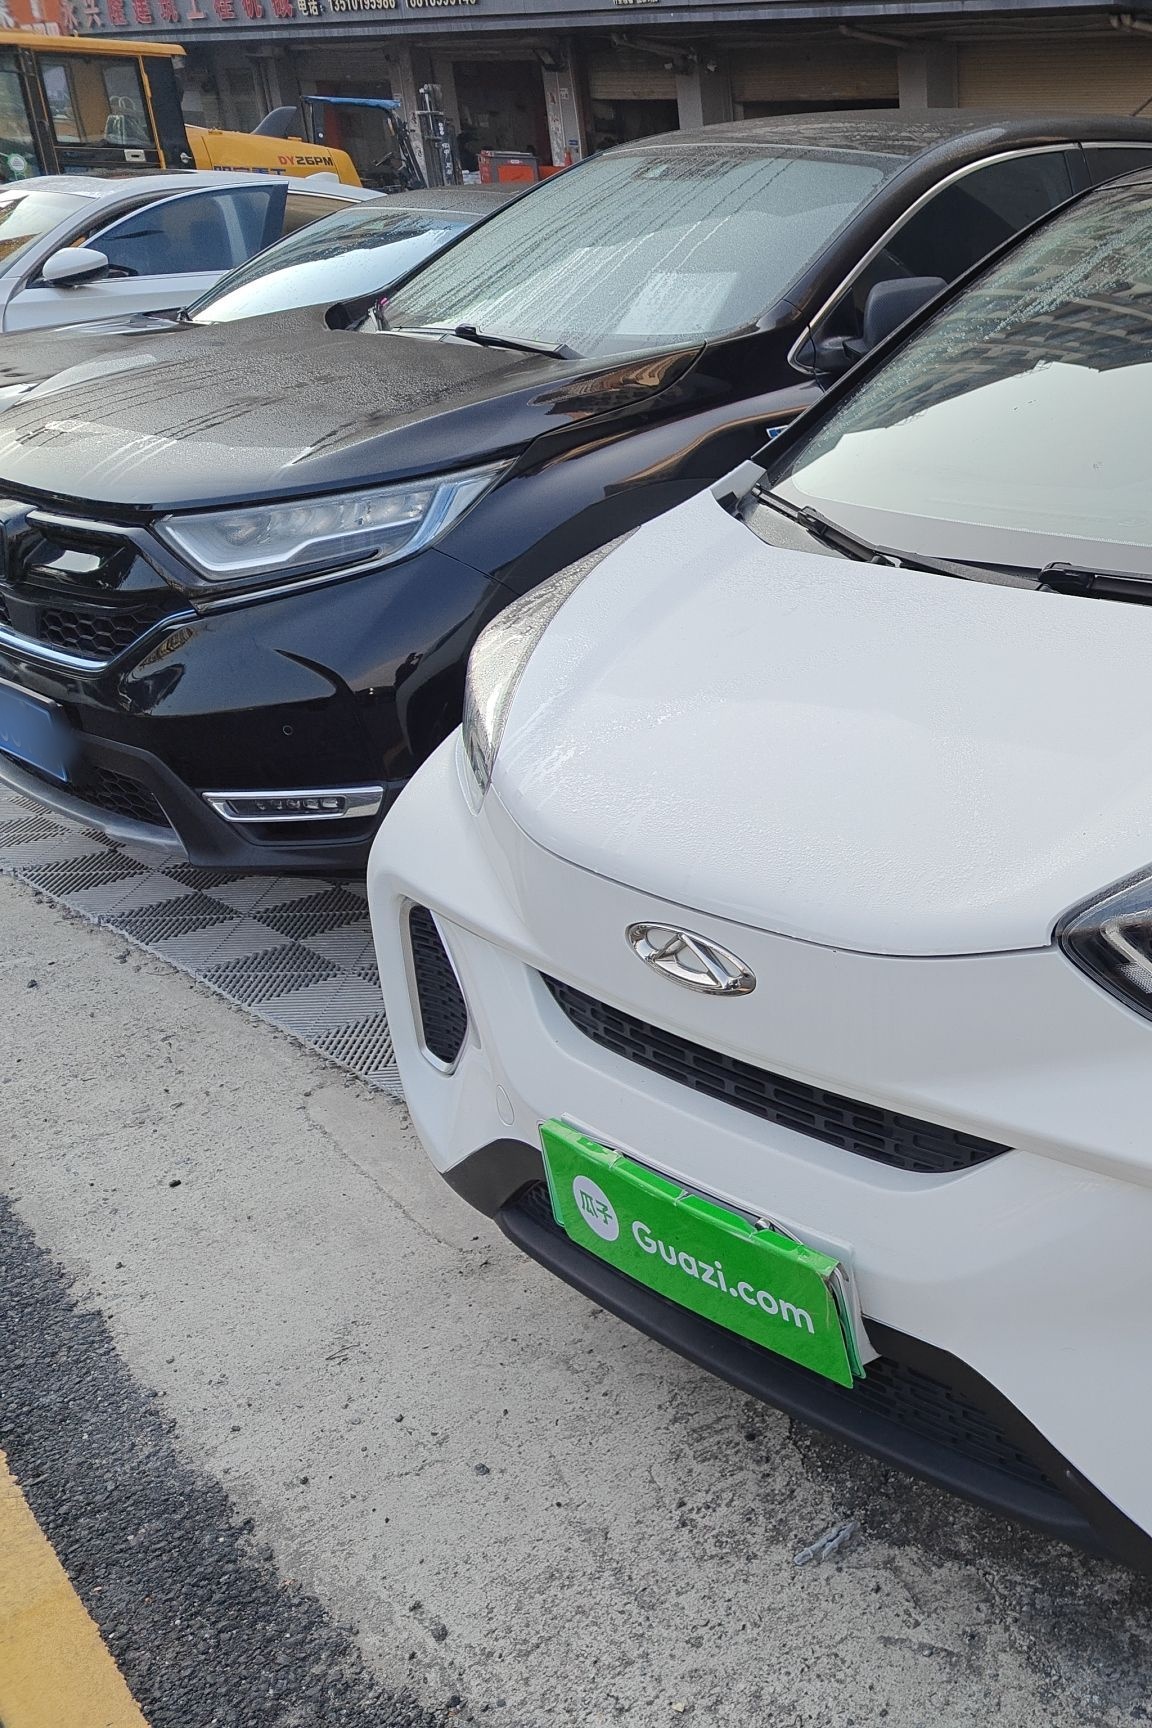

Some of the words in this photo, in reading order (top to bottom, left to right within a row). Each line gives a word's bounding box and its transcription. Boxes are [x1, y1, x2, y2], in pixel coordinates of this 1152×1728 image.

[277, 155, 333, 167] DY26PM
[578, 1189, 613, 1225] 瓜子
[631, 1220, 815, 1335] Guazi.com
